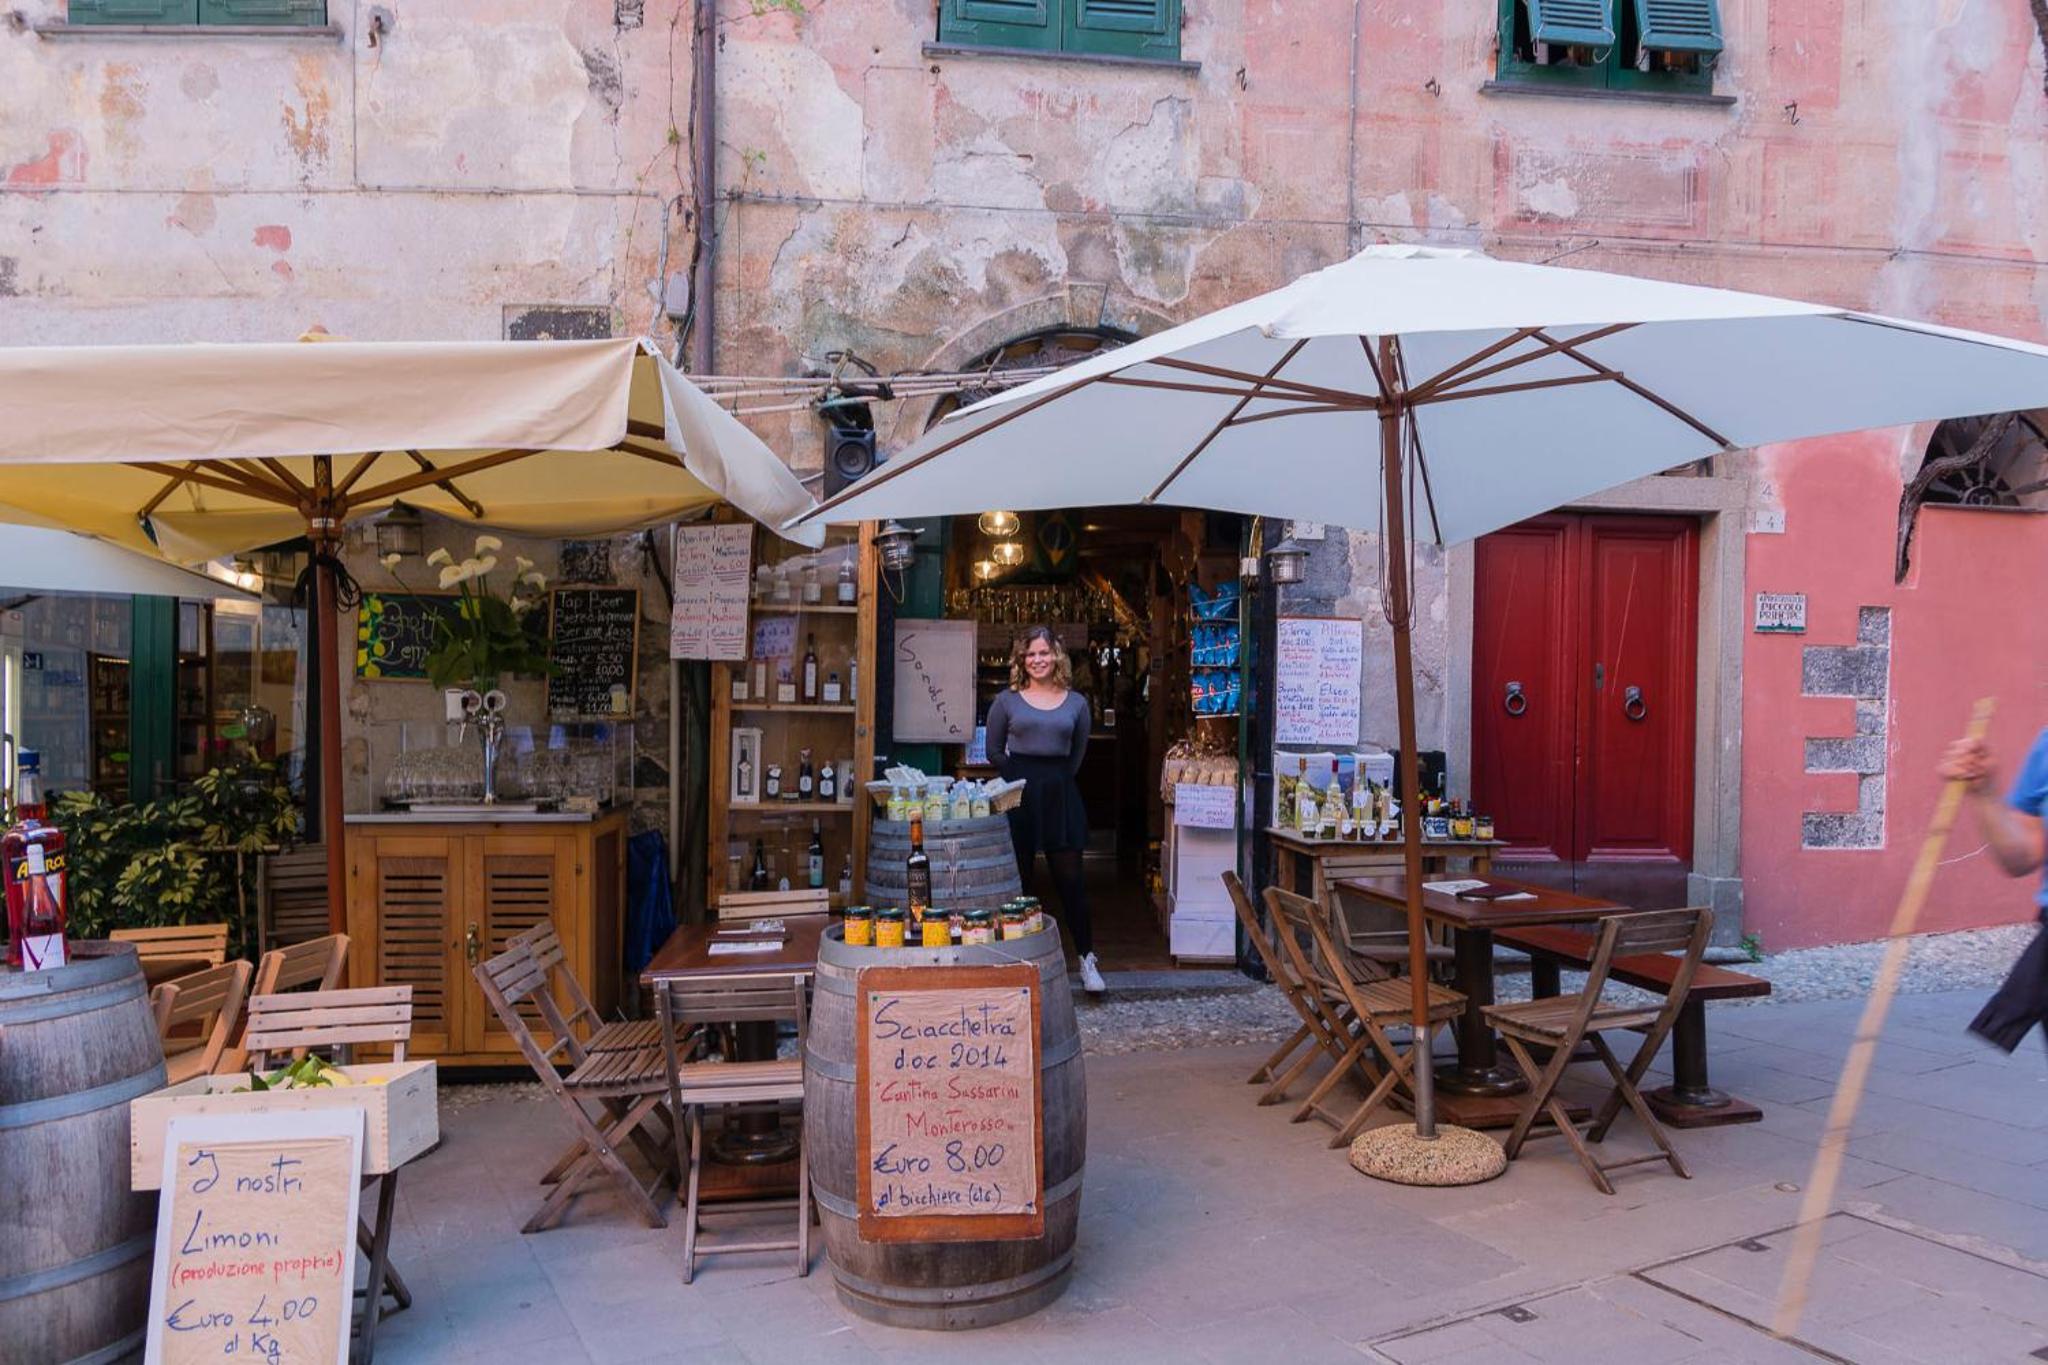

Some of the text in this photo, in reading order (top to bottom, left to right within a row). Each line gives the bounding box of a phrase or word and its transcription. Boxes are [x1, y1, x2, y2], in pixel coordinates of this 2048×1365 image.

[899, 633, 962, 735] Sangria
[949, 1041, 1008, 1070] 2014
[948, 1075, 1019, 1101] Sassarini
[236, 1153, 303, 1196] nostri
[180, 1208, 279, 1256] Limoni
[170, 1261, 266, 1290] (produzione
[248, 1293, 318, 1330] 4,00
[224, 1332, 282, 1365] al Kg
